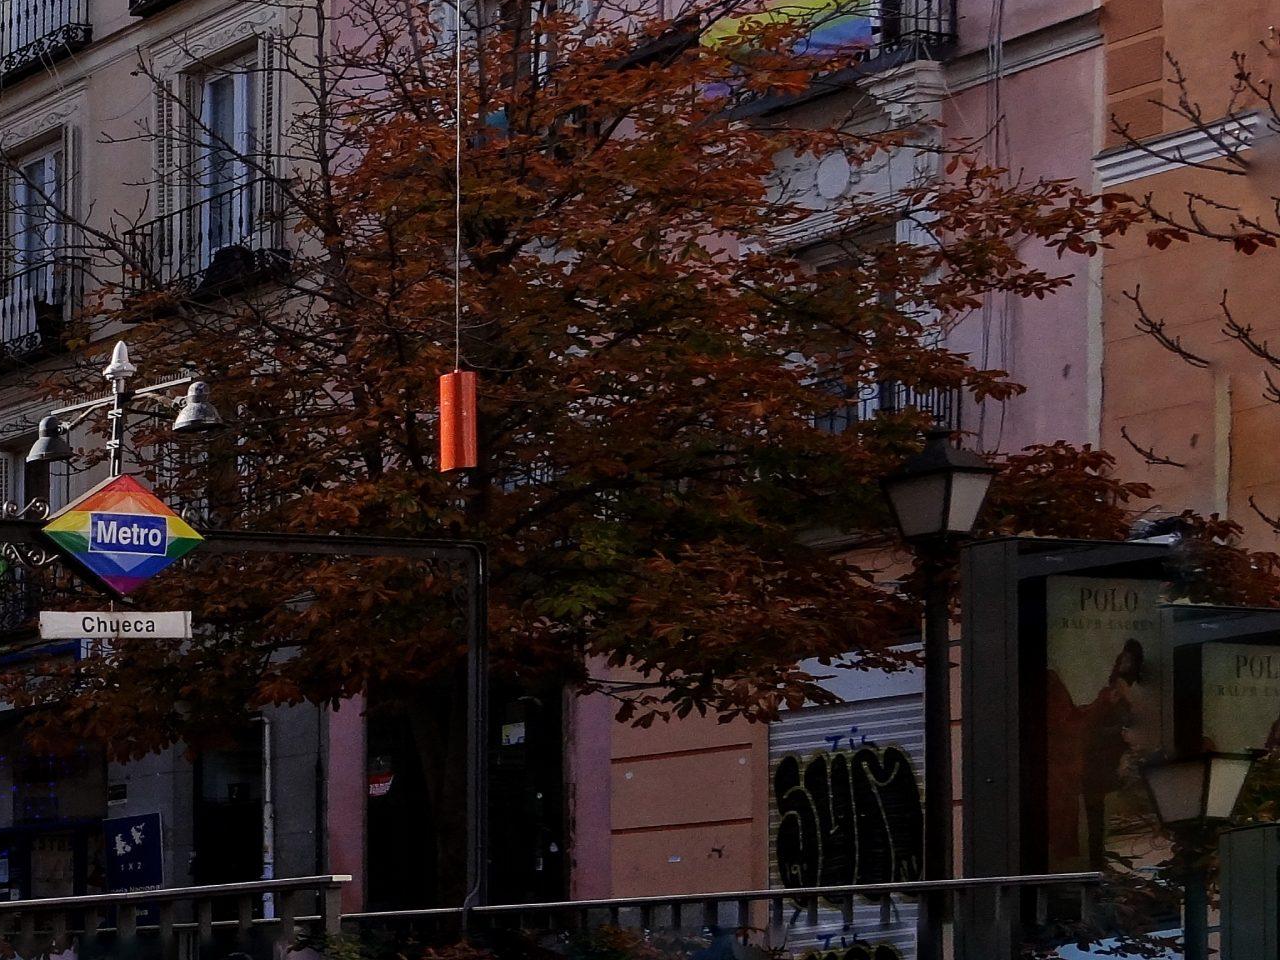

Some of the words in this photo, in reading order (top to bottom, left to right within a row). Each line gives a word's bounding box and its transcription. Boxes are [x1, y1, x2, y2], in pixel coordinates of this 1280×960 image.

[96, 520, 162, 547] Metro
[1080, 587, 1139, 611] POLO
[81, 616, 156, 634] Chueca
